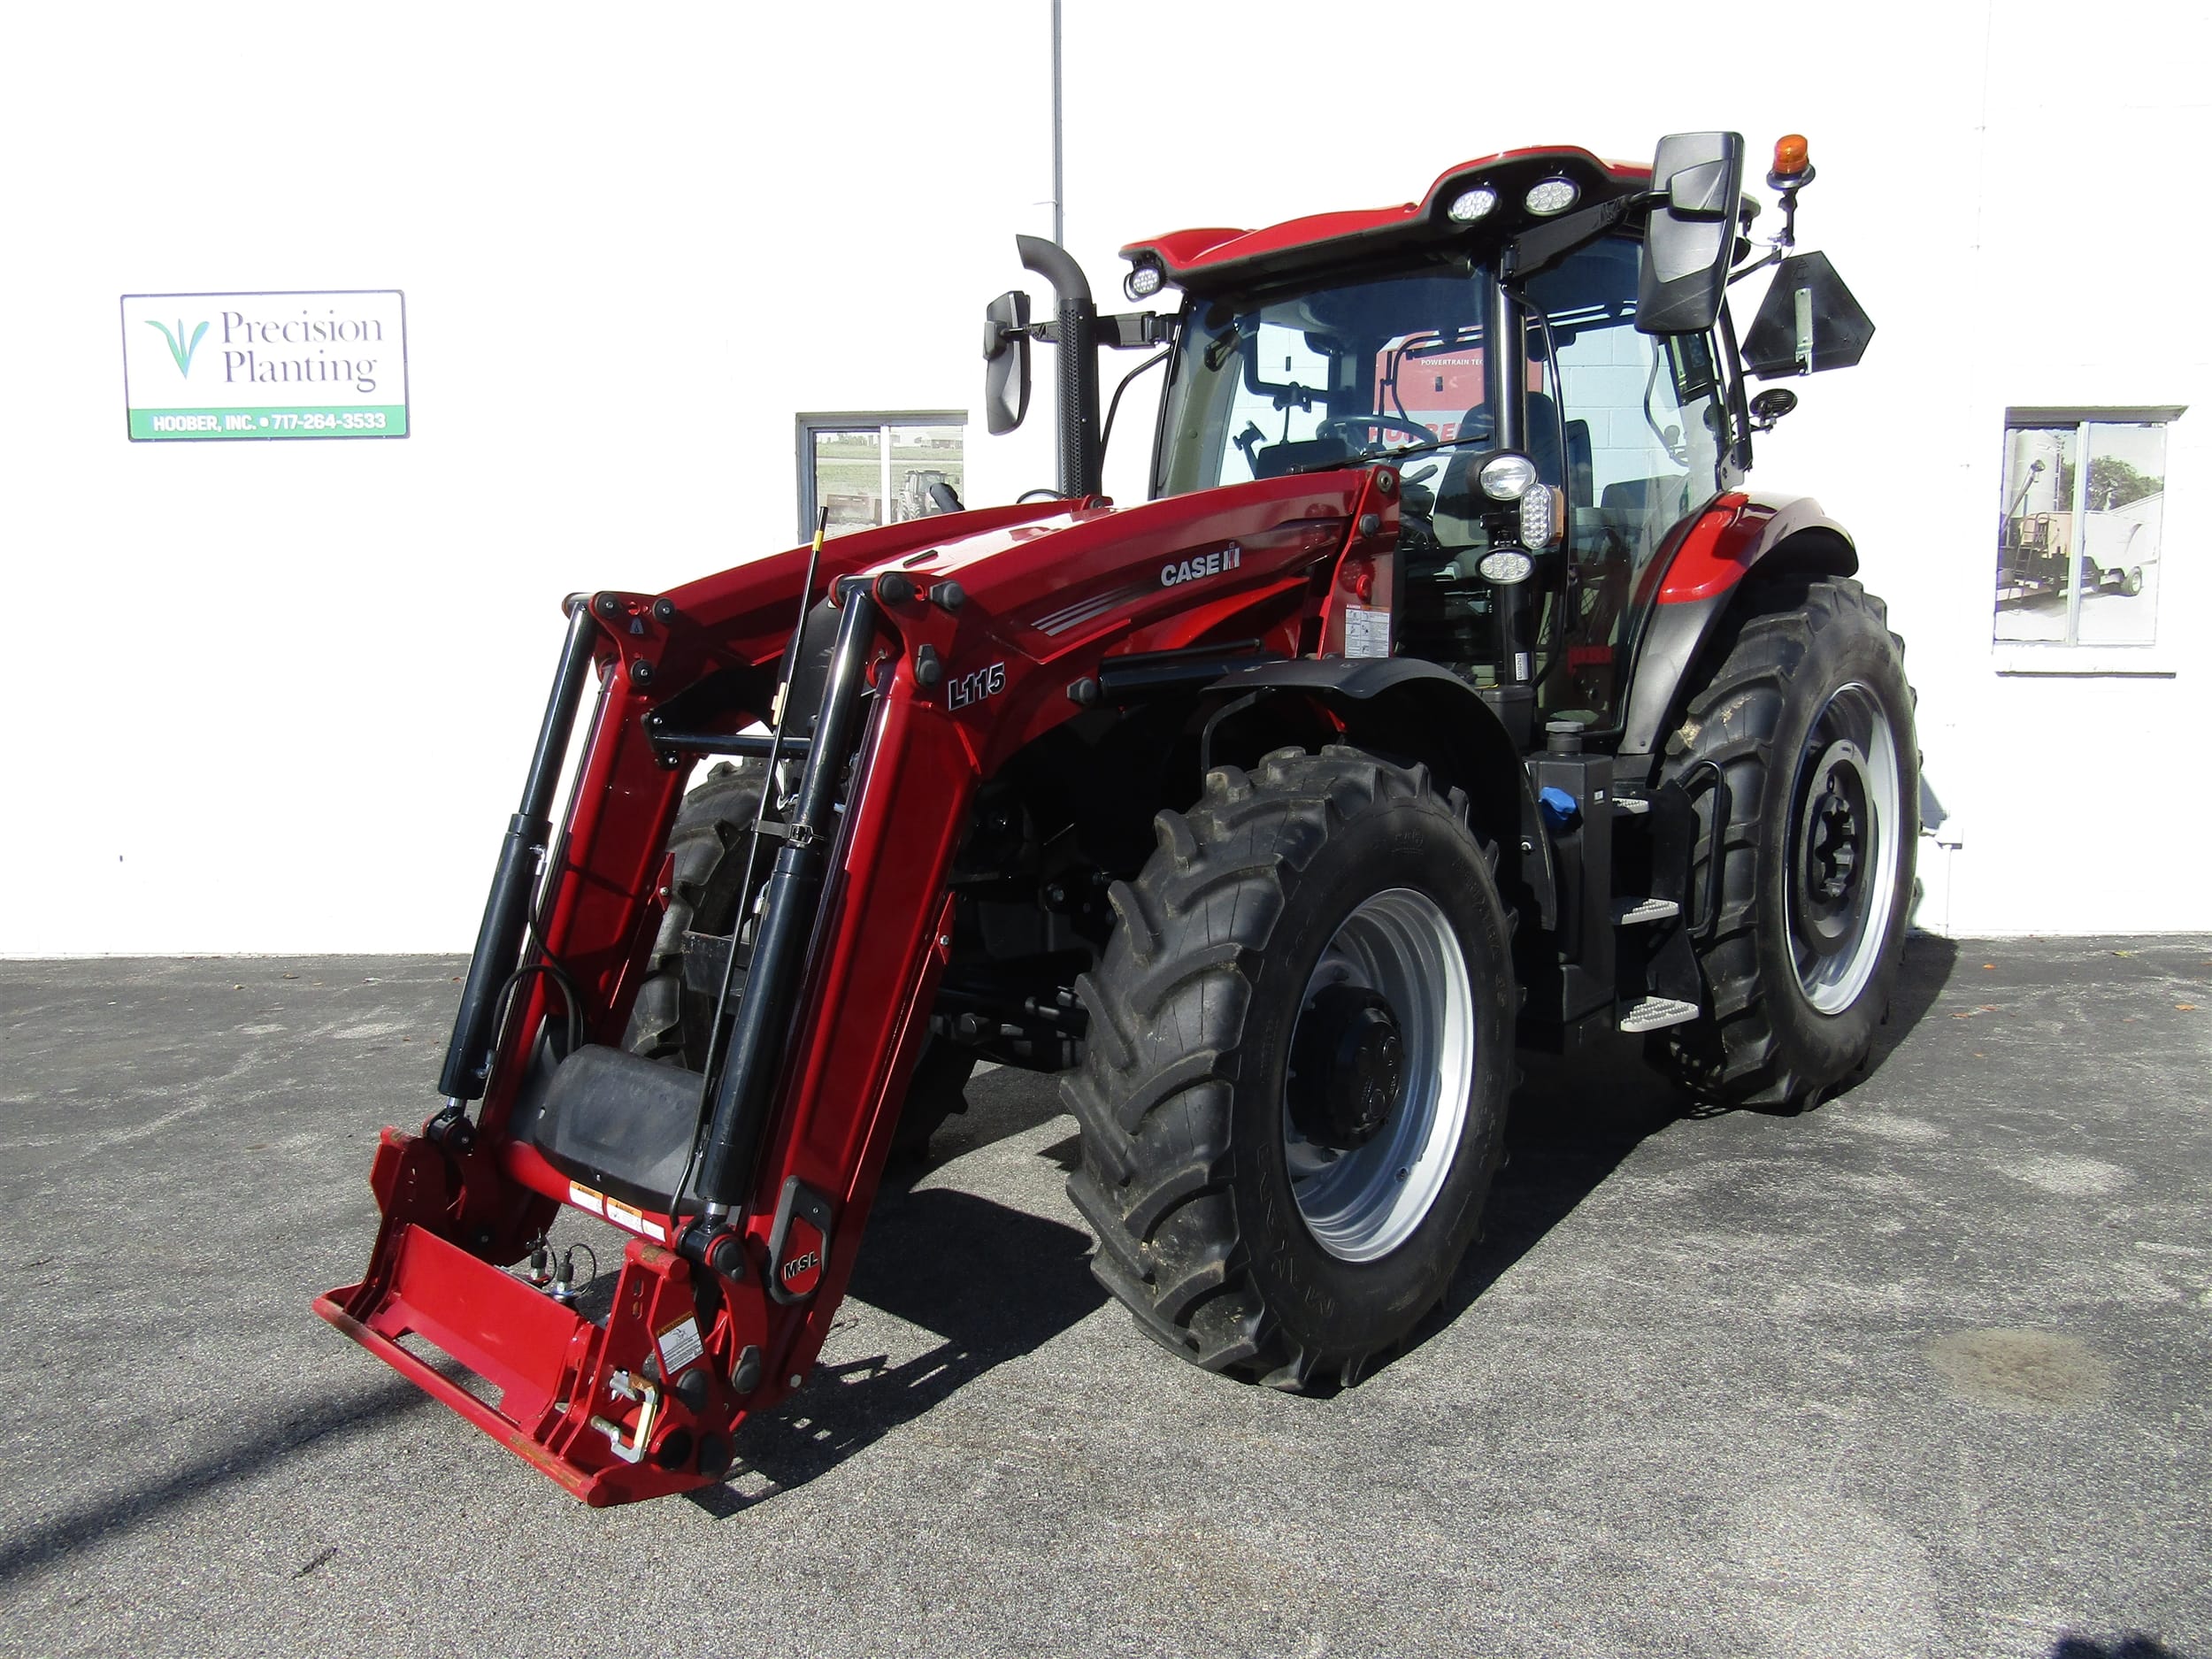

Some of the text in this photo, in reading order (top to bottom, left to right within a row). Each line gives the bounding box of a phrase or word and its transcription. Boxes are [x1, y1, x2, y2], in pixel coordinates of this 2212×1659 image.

[220, 310, 383, 344] Precision
[222, 349, 378, 394] Planting
[153, 412, 387, 433] HOOBER, INC. 717-264-3533
[1161, 553, 1220, 587] CASE
[949, 661, 1006, 711] L115
[784, 1250, 818, 1281] MSL
